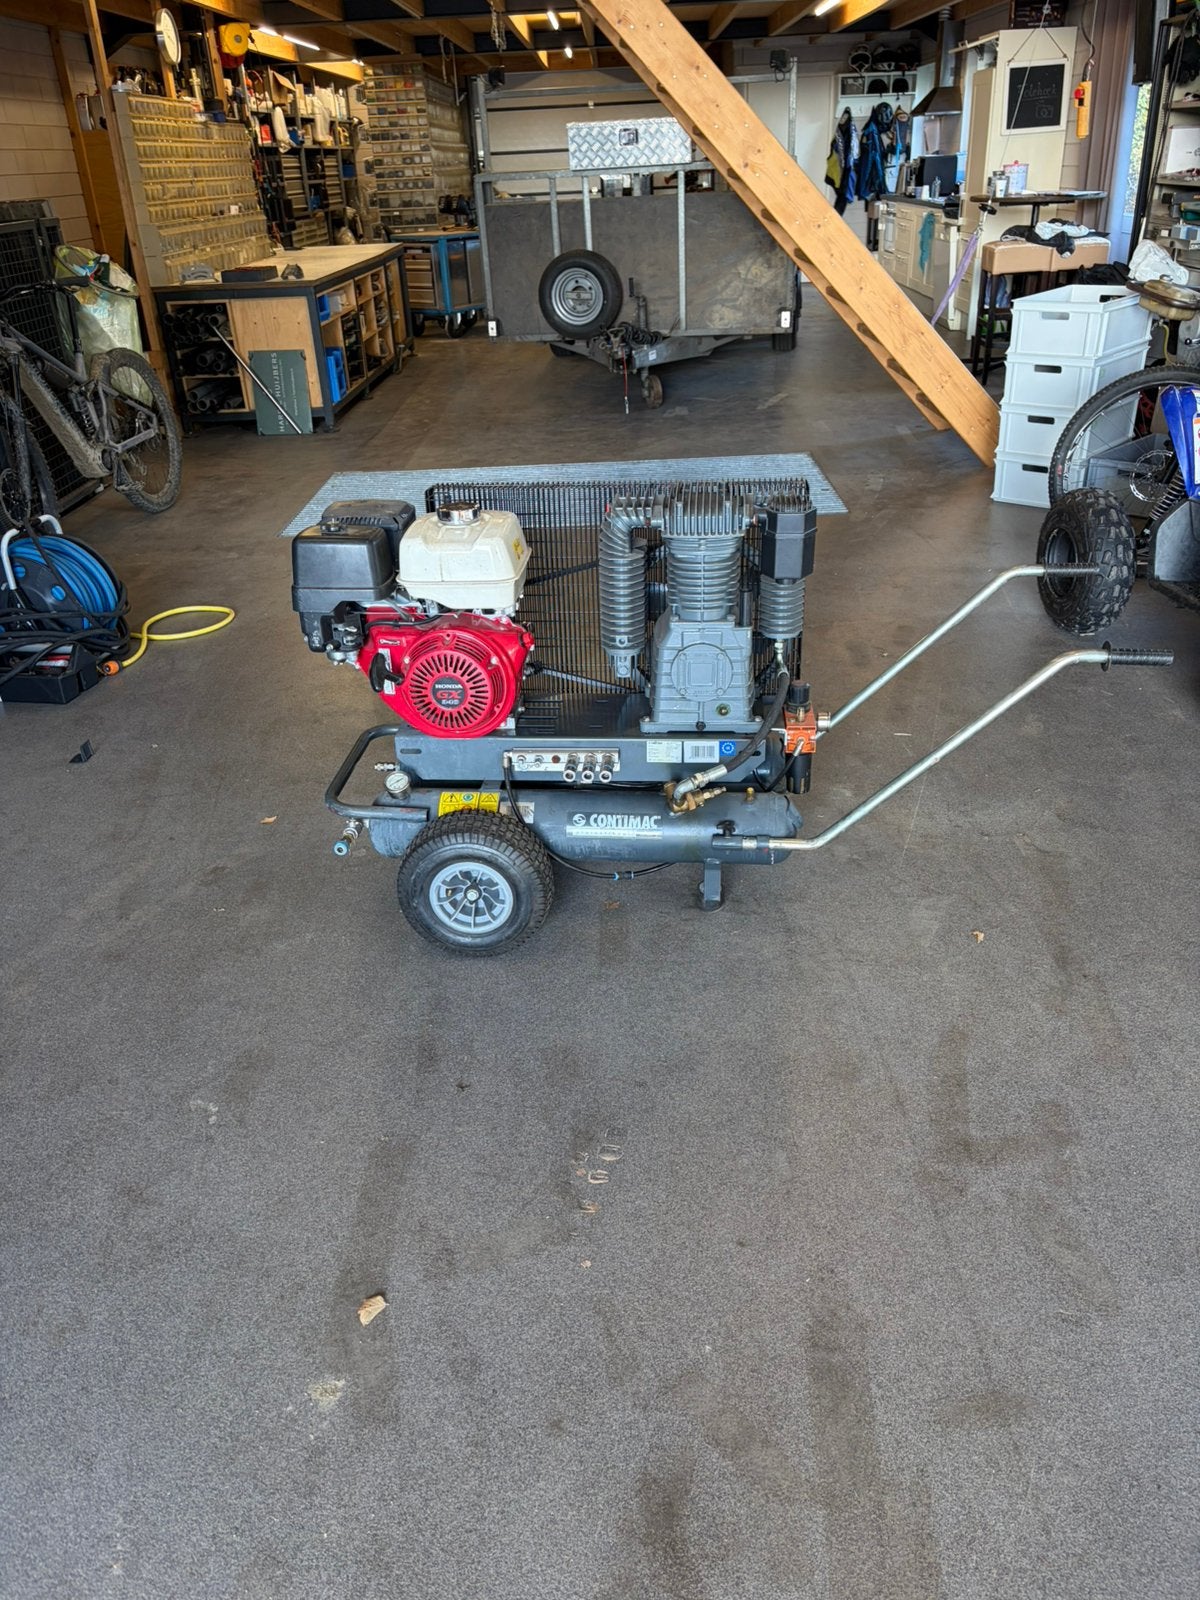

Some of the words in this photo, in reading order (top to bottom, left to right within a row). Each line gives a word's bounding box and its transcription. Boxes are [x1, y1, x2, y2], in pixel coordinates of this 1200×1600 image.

[271, 352, 281, 397] HUIJBERS
[436, 690, 462, 700] GX
[589, 813, 661, 829] CONTIMAC
